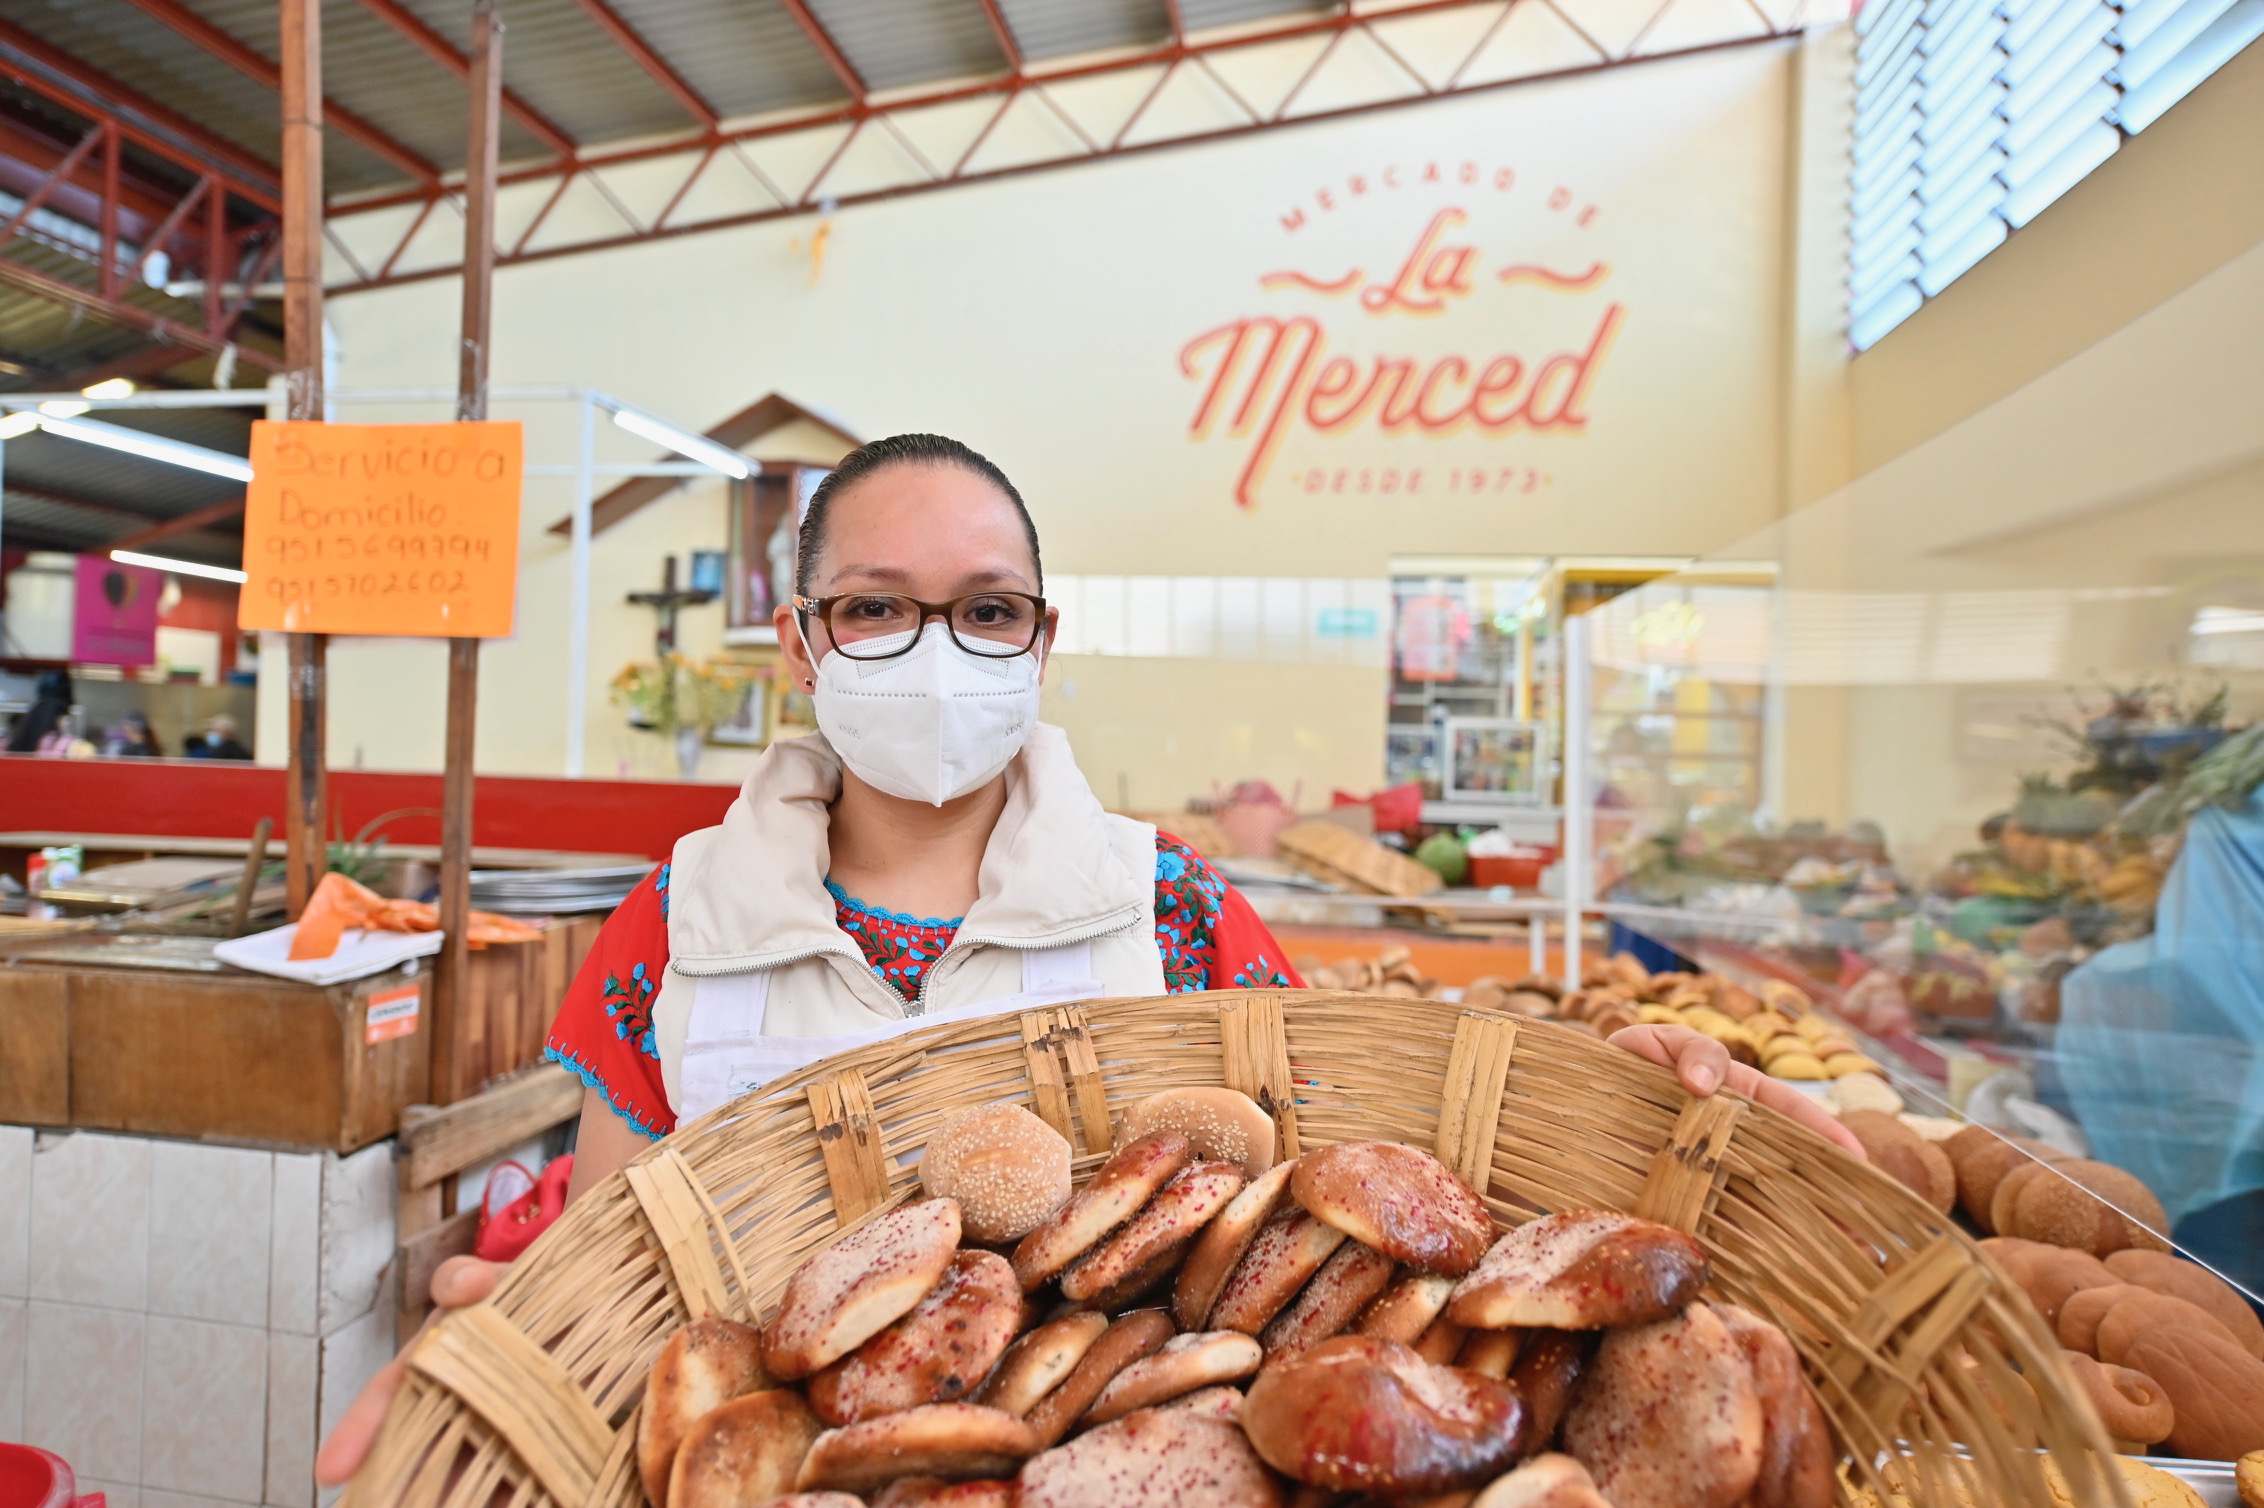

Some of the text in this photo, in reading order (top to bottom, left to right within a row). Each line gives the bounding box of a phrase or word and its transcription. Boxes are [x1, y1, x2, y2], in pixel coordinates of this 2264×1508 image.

[1277, 161, 1602, 235] MERCADO DE
[1360, 206, 1480, 316] La
[1178, 301, 1627, 512] Merced
[274, 437, 505, 483] Servicio a
[1303, 466, 1541, 496] DESDE 1973
